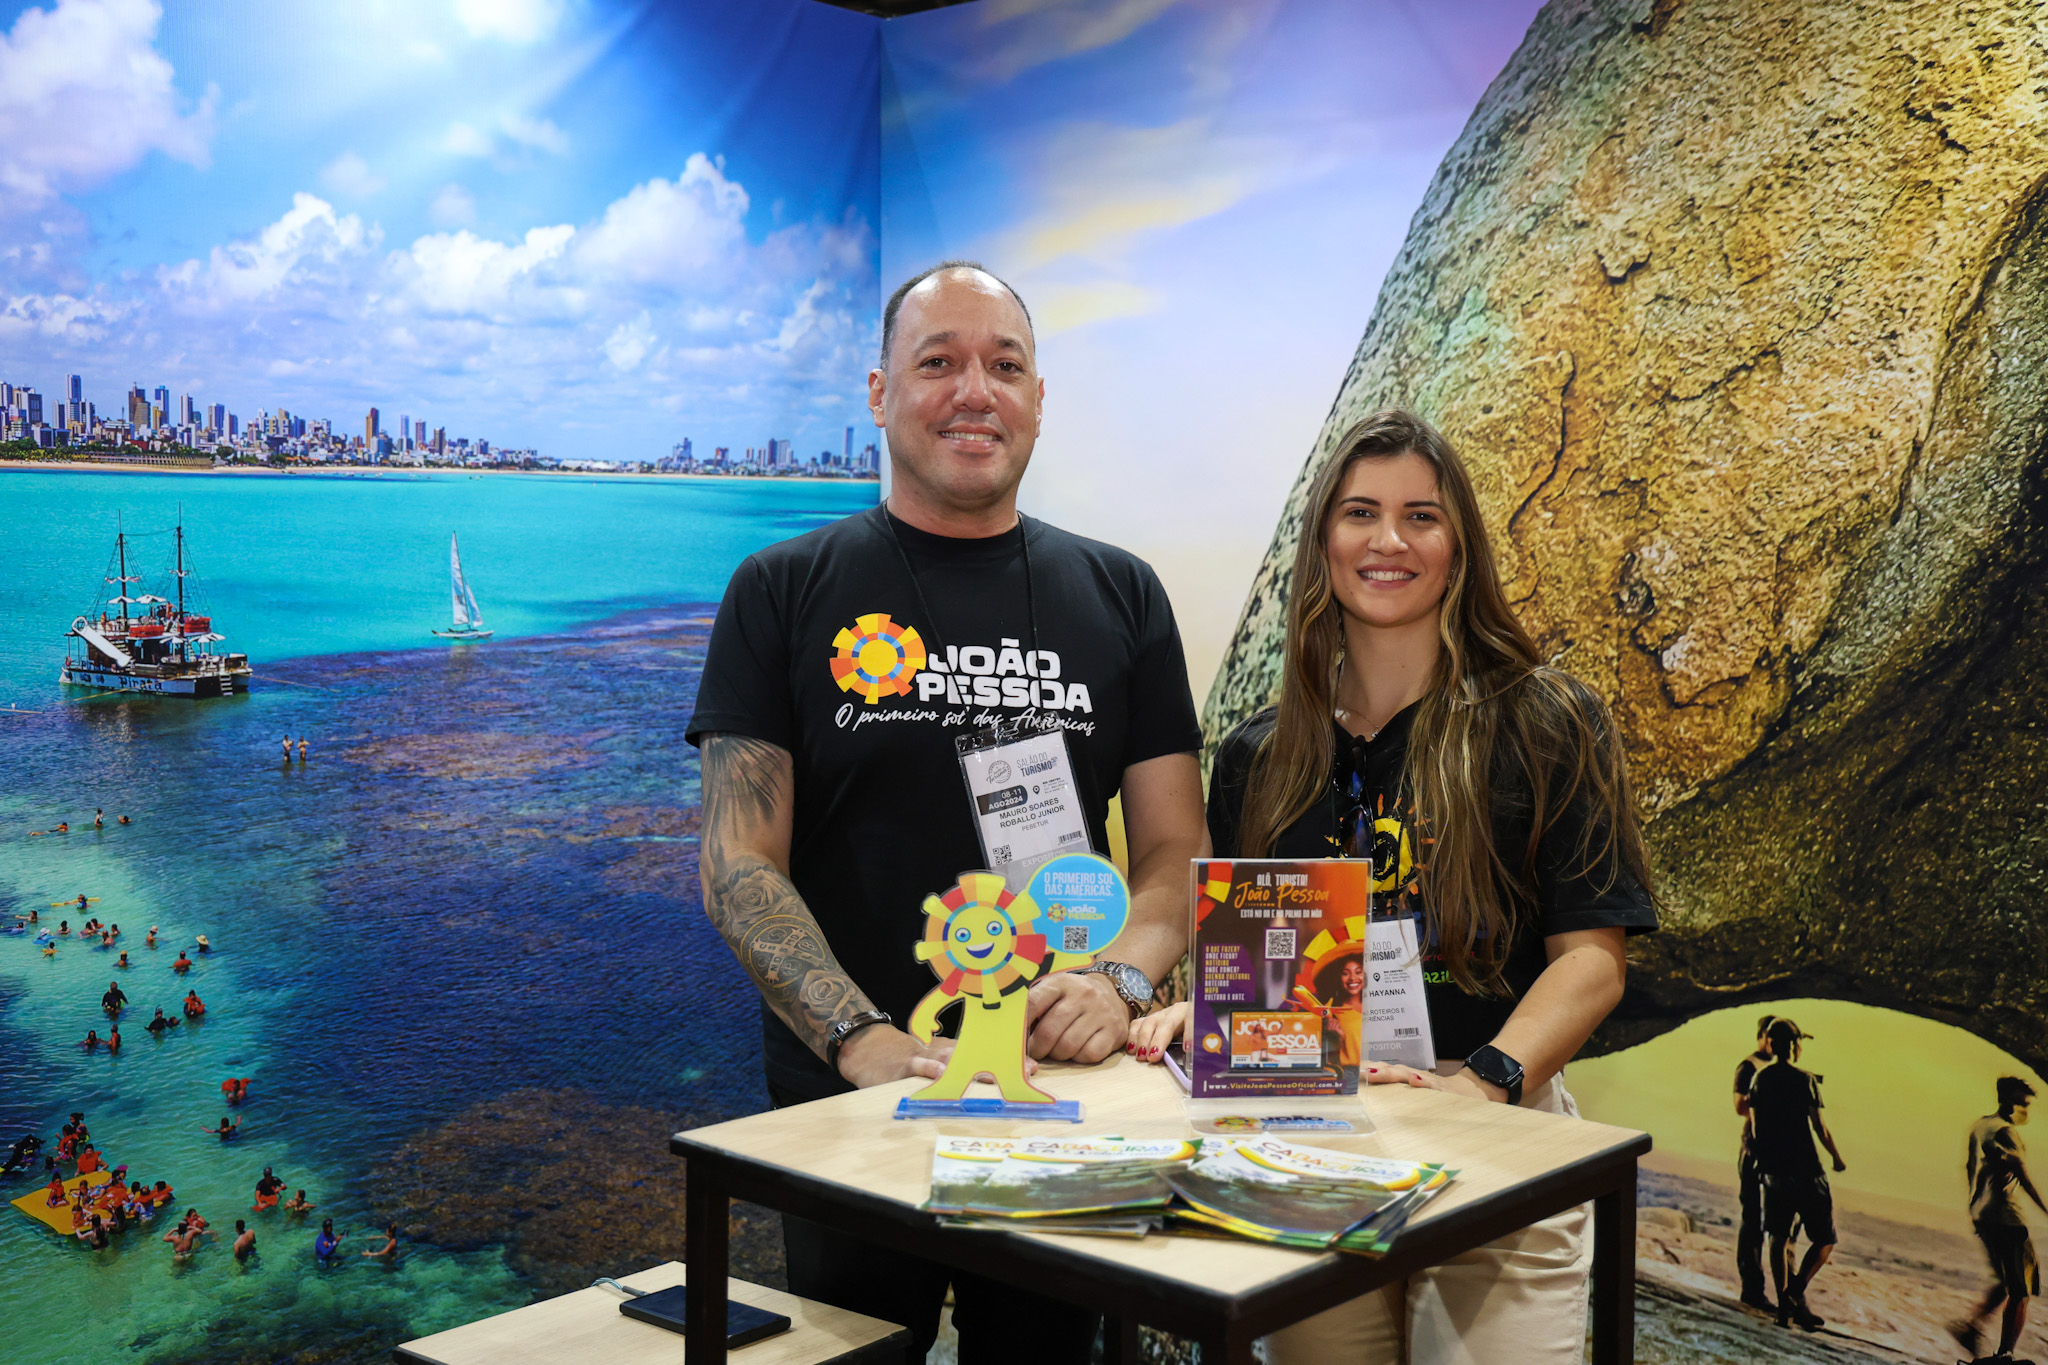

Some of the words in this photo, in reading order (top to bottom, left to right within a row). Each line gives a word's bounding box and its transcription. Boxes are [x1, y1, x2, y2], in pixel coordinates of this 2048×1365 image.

[928, 637, 1061, 680] JOÃO
[916, 672, 1093, 714] PESSOA
[835, 702, 854, 728] O
[852, 705, 939, 732] primeiro
[942, 706, 970, 728] sol
[973, 707, 1004, 729] das
[1016, 754, 1039, 769] SALÃO
[1039, 752, 1048, 763] DO
[1020, 760, 1053, 777] TURISMO
[1001, 788, 1022, 799] 08-11
[988, 796, 1024, 811] AGO2024
[999, 806, 1028, 820] MAURO
[1029, 797, 1060, 811] SOARES
[1000, 813, 1036, 828] ROBALLO
[1038, 804, 1065, 818] JUNIOR
[1044, 872, 1051, 883] O
[1052, 872, 1096, 884] PRIMEIRO
[1097, 873, 1115, 885] SOL
[1275, 874, 1308, 887] TURISTA!
[1044, 884, 1063, 896] DAS
[1234, 881, 1271, 909] João
[1276, 881, 1330, 909] Pessoa
[1067, 904, 1097, 914] JOÃO
[1267, 1034, 1319, 1049] ESSOA
[1368, 1042, 1401, 1051] POSITOR
